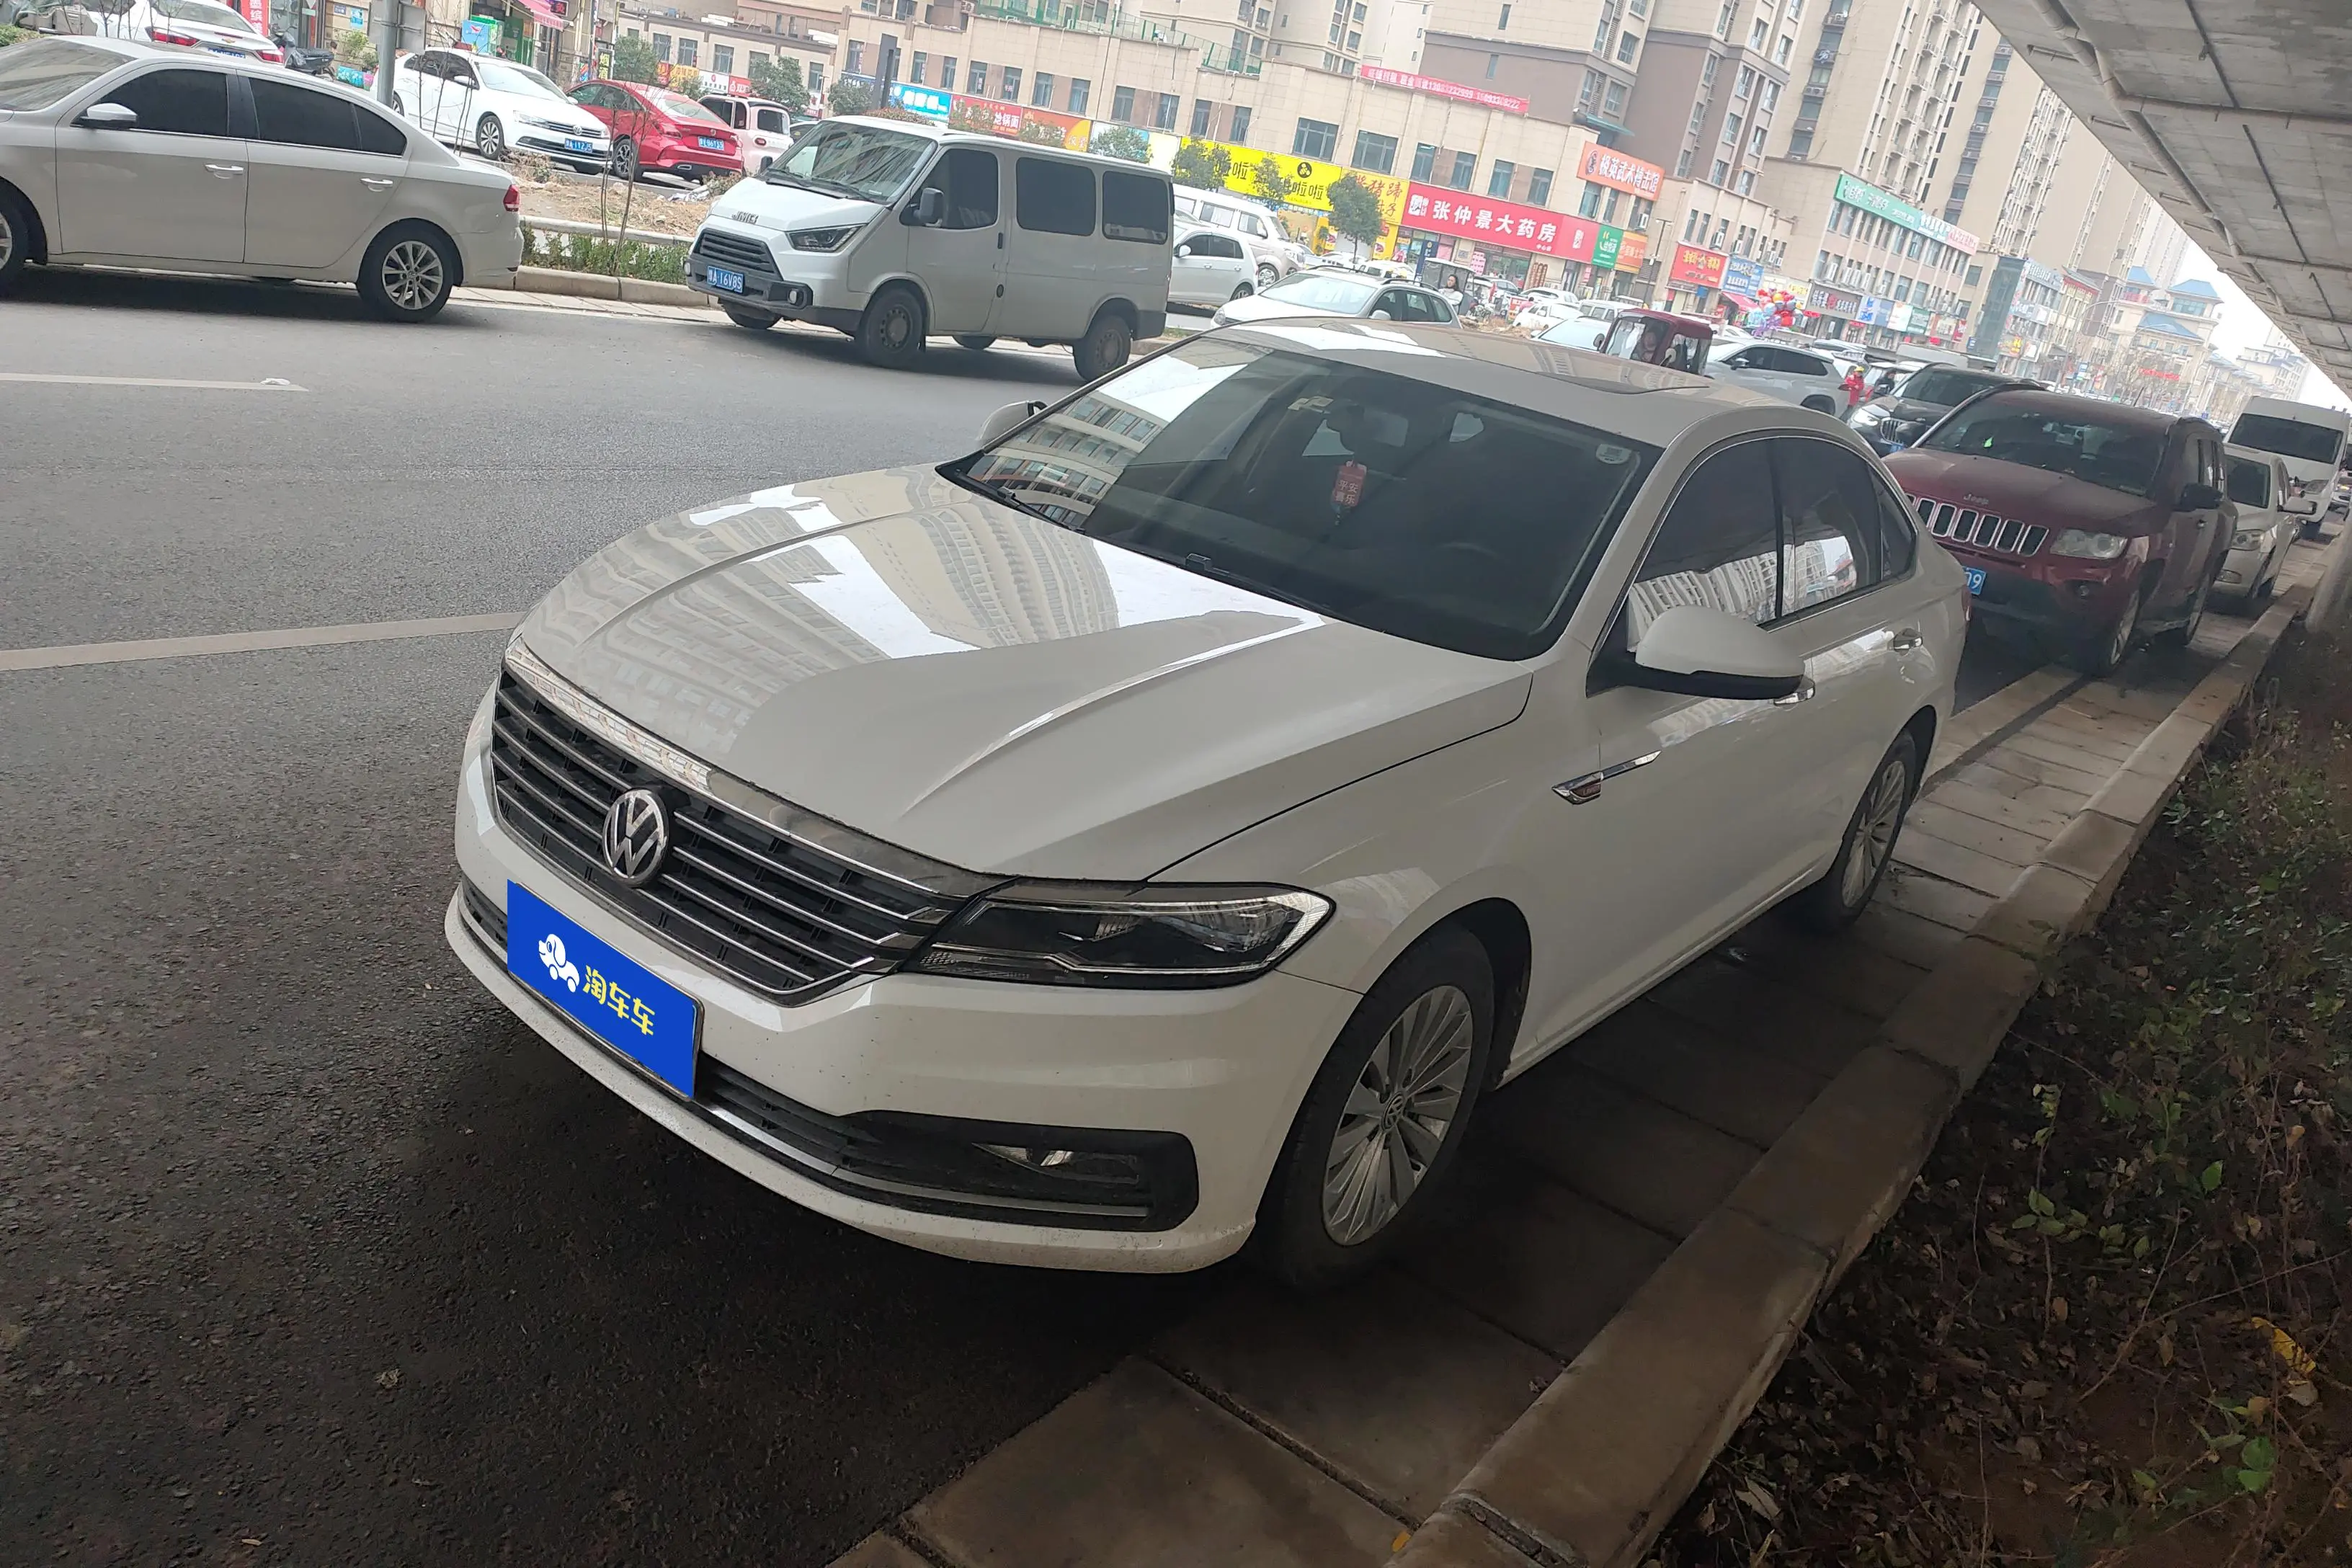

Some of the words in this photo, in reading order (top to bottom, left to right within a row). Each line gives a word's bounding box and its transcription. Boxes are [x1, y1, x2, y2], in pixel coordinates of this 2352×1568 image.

[1433, 200, 1557, 243] 张仲景大药房
[1338, 479, 1358, 493] 平安
[1963, 493, 1990, 505] Jeep
